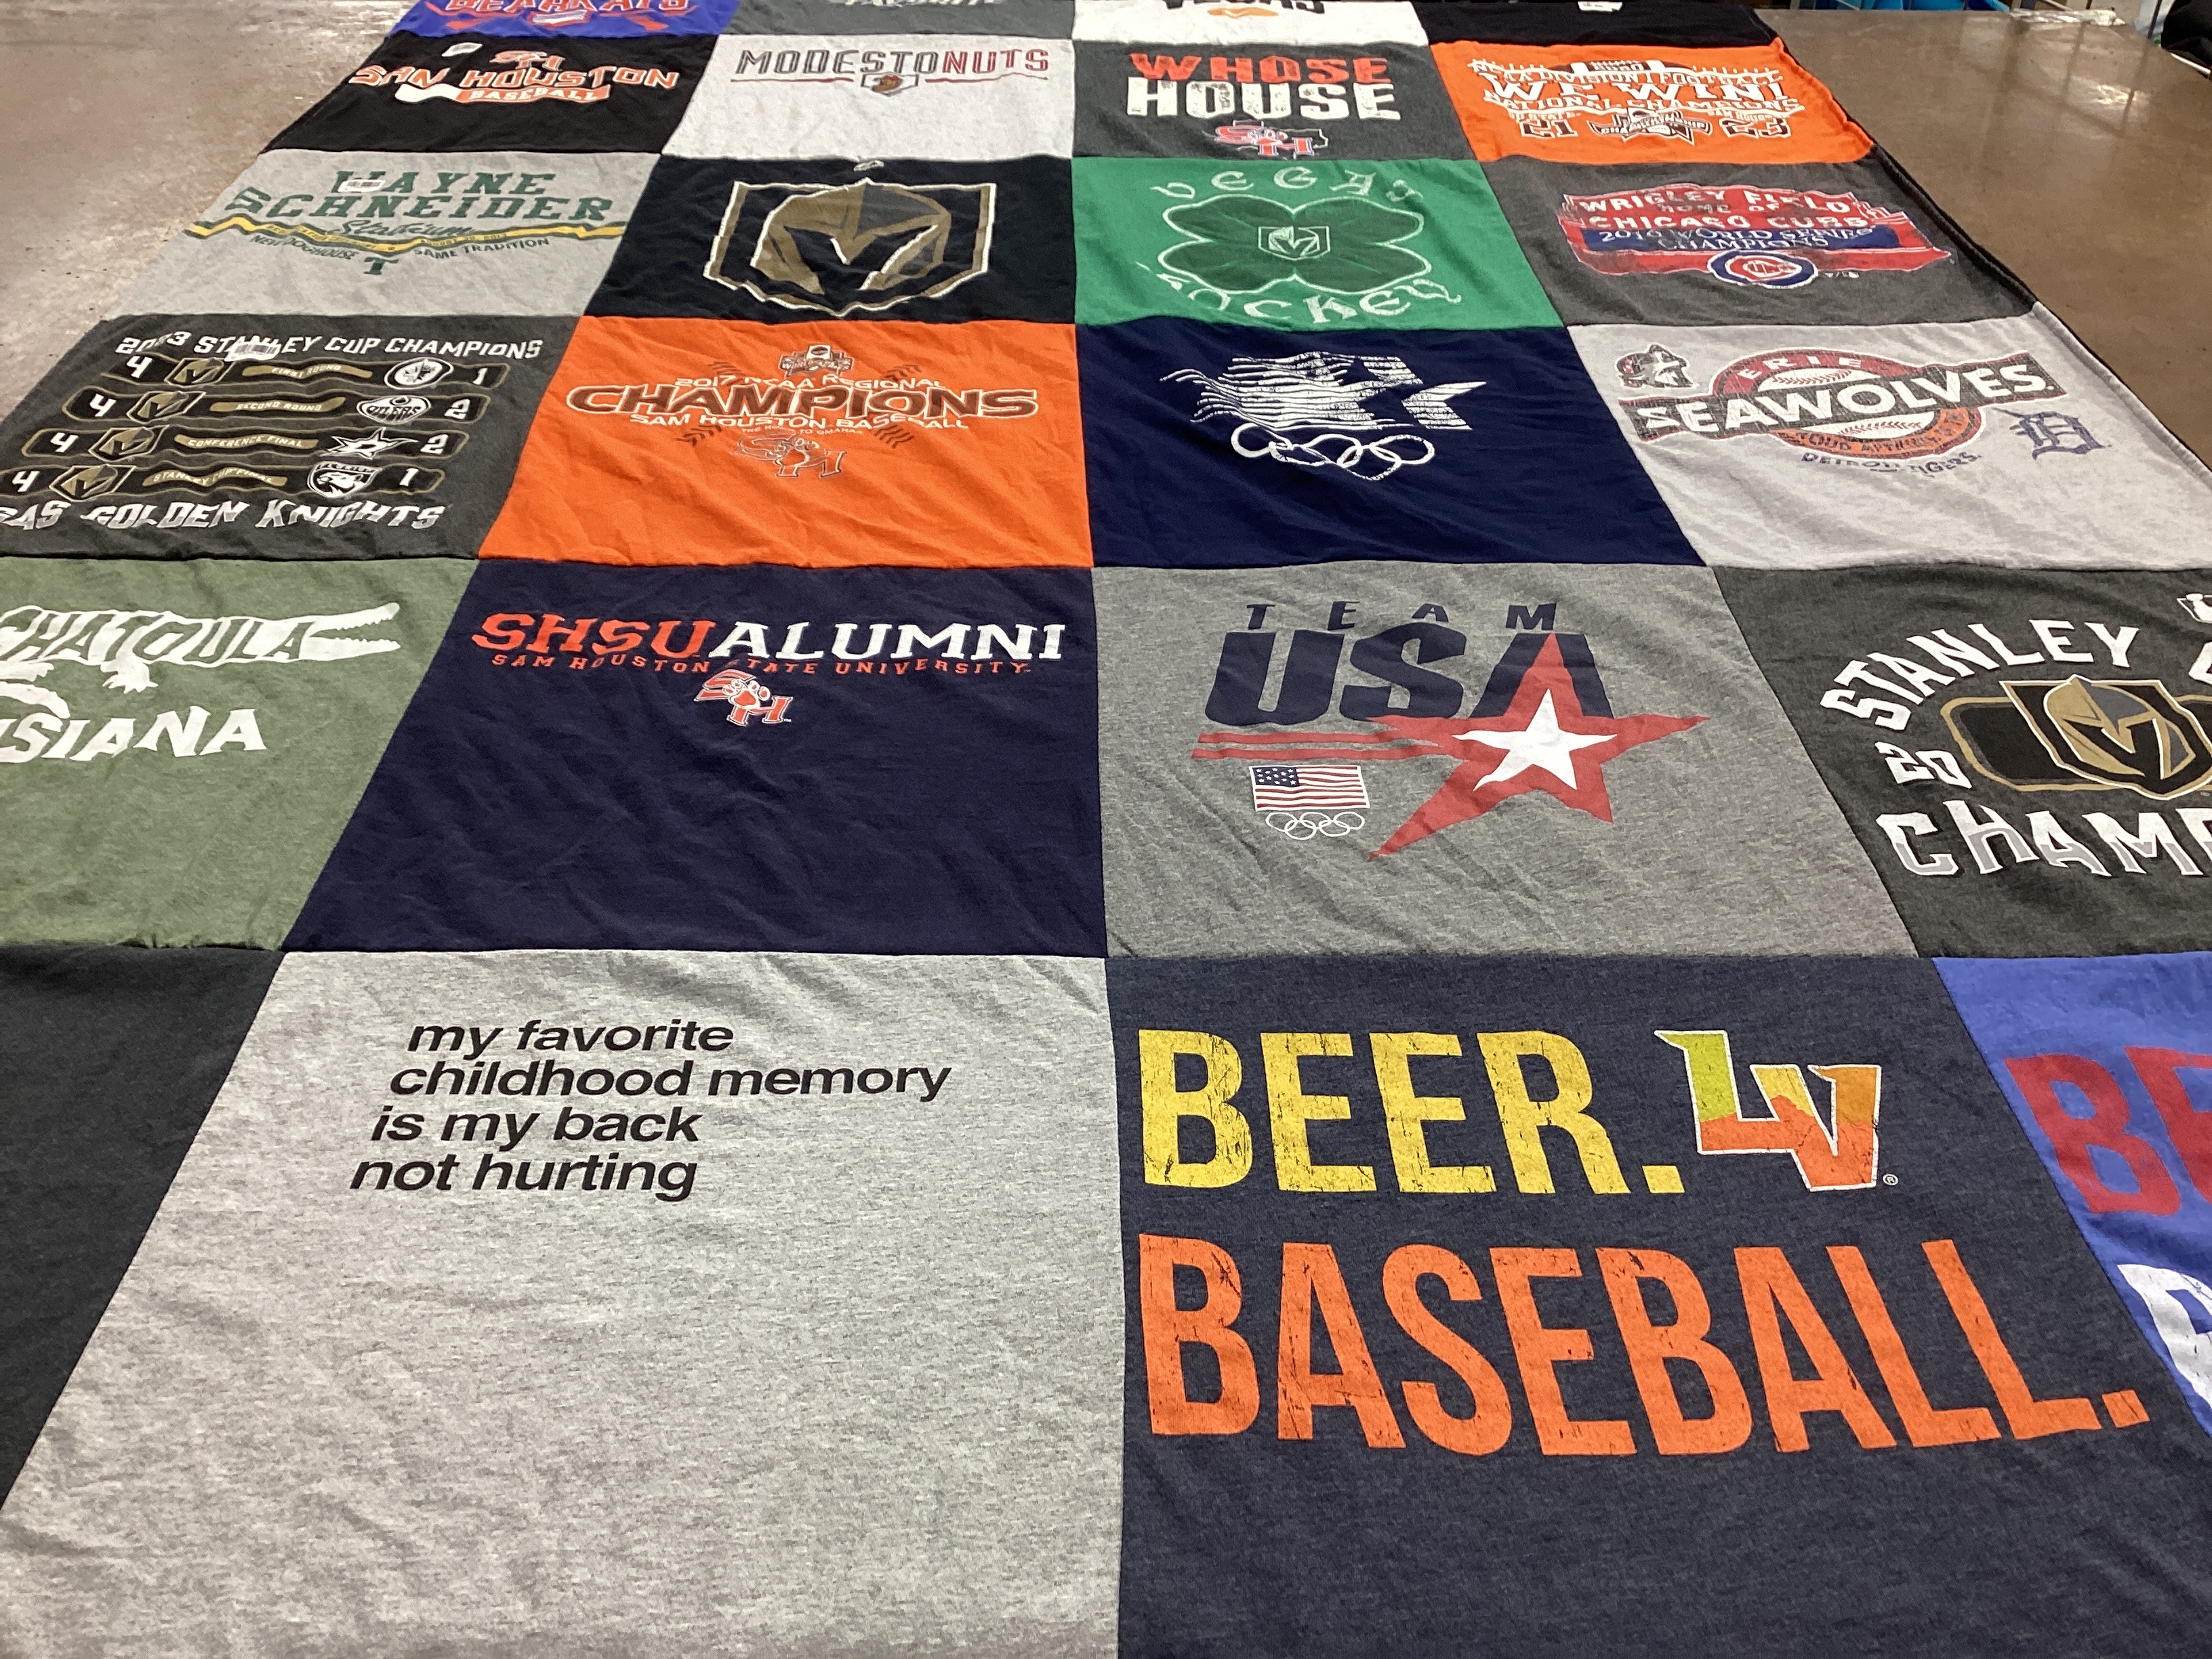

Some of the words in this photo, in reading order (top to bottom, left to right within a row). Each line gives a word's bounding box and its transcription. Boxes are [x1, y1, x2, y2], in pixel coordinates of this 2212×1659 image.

[348, 64, 450, 88] SAM
[459, 66, 679, 89] HOUSTON
[1130, 52, 1391, 84] WHOSE
[467, 87, 599, 102] BASEBALL
[1126, 76, 1401, 120] HOUSE
[1478, 73, 1600, 100] WE
[1612, 82, 1788, 101] WIN!
[1483, 89, 1622, 110] NATIONAL
[1719, 118, 1791, 139] 23
[224, 186, 614, 221] SCHNEIDER
[1579, 190, 1725, 212] WRIGLEY
[1658, 203, 1732, 213] HOME
[1589, 215, 1751, 228] CHICAGO
[1767, 216, 1869, 228] CUBS
[1669, 227, 1773, 240] WORLD
[462, 238, 550, 254] TRADITION
[363, 256, 399, 275] T
[325, 337, 381, 354] CUP
[384, 337, 544, 359] CHAMPIONS
[126, 356, 153, 378] 4
[271, 367, 304, 379] FIRST
[306, 364, 342, 376] ROUND
[472, 367, 488, 385] 1
[1744, 355, 1864, 381] ERIE
[675, 375, 737, 387] 2017
[822, 373, 947, 390] REGIONAL
[87, 394, 117, 418] 4
[236, 400, 281, 409] SECOND
[445, 398, 470, 419] 2
[566, 384, 1040, 421] CHAMPIONS
[630, 413, 692, 428] SAM
[699, 415, 827, 429] HOUSTON
[836, 413, 969, 430] BASEBALL
[50, 432, 79, 453] 4
[188, 435, 264, 446] CONFERENCE
[267, 434, 304, 447] FINAL
[420, 434, 449, 455] 2
[12, 470, 40, 492] 4
[237, 468, 273, 483] FINAL
[399, 468, 419, 486] 1
[80, 501, 251, 529] GOLDEN
[255, 499, 447, 529] KNIGHTS
[1246, 600, 1557, 631] TEAM
[491, 654, 555, 668] SAM
[569, 653, 710, 673] HOUSTON
[835, 657, 1025, 675] UNIVERSITY
[1204, 621, 1615, 726] USA
[1820, 619, 2140, 731] STANLEY
[407, 1024, 503, 1061] my
[516, 1019, 735, 1052] favorite
[389, 1061, 695, 1097] childhood
[708, 1065, 953, 1103] memory
[1137, 1028, 1686, 1195] BEER.
[370, 1105, 423, 1142] is
[440, 1111, 541, 1153] my
[553, 1107, 703, 1143] back
[348, 1153, 458, 1191] not
[470, 1153, 699, 1202] hurting
[1137, 1232, 2151, 1457] BASEBALL.
